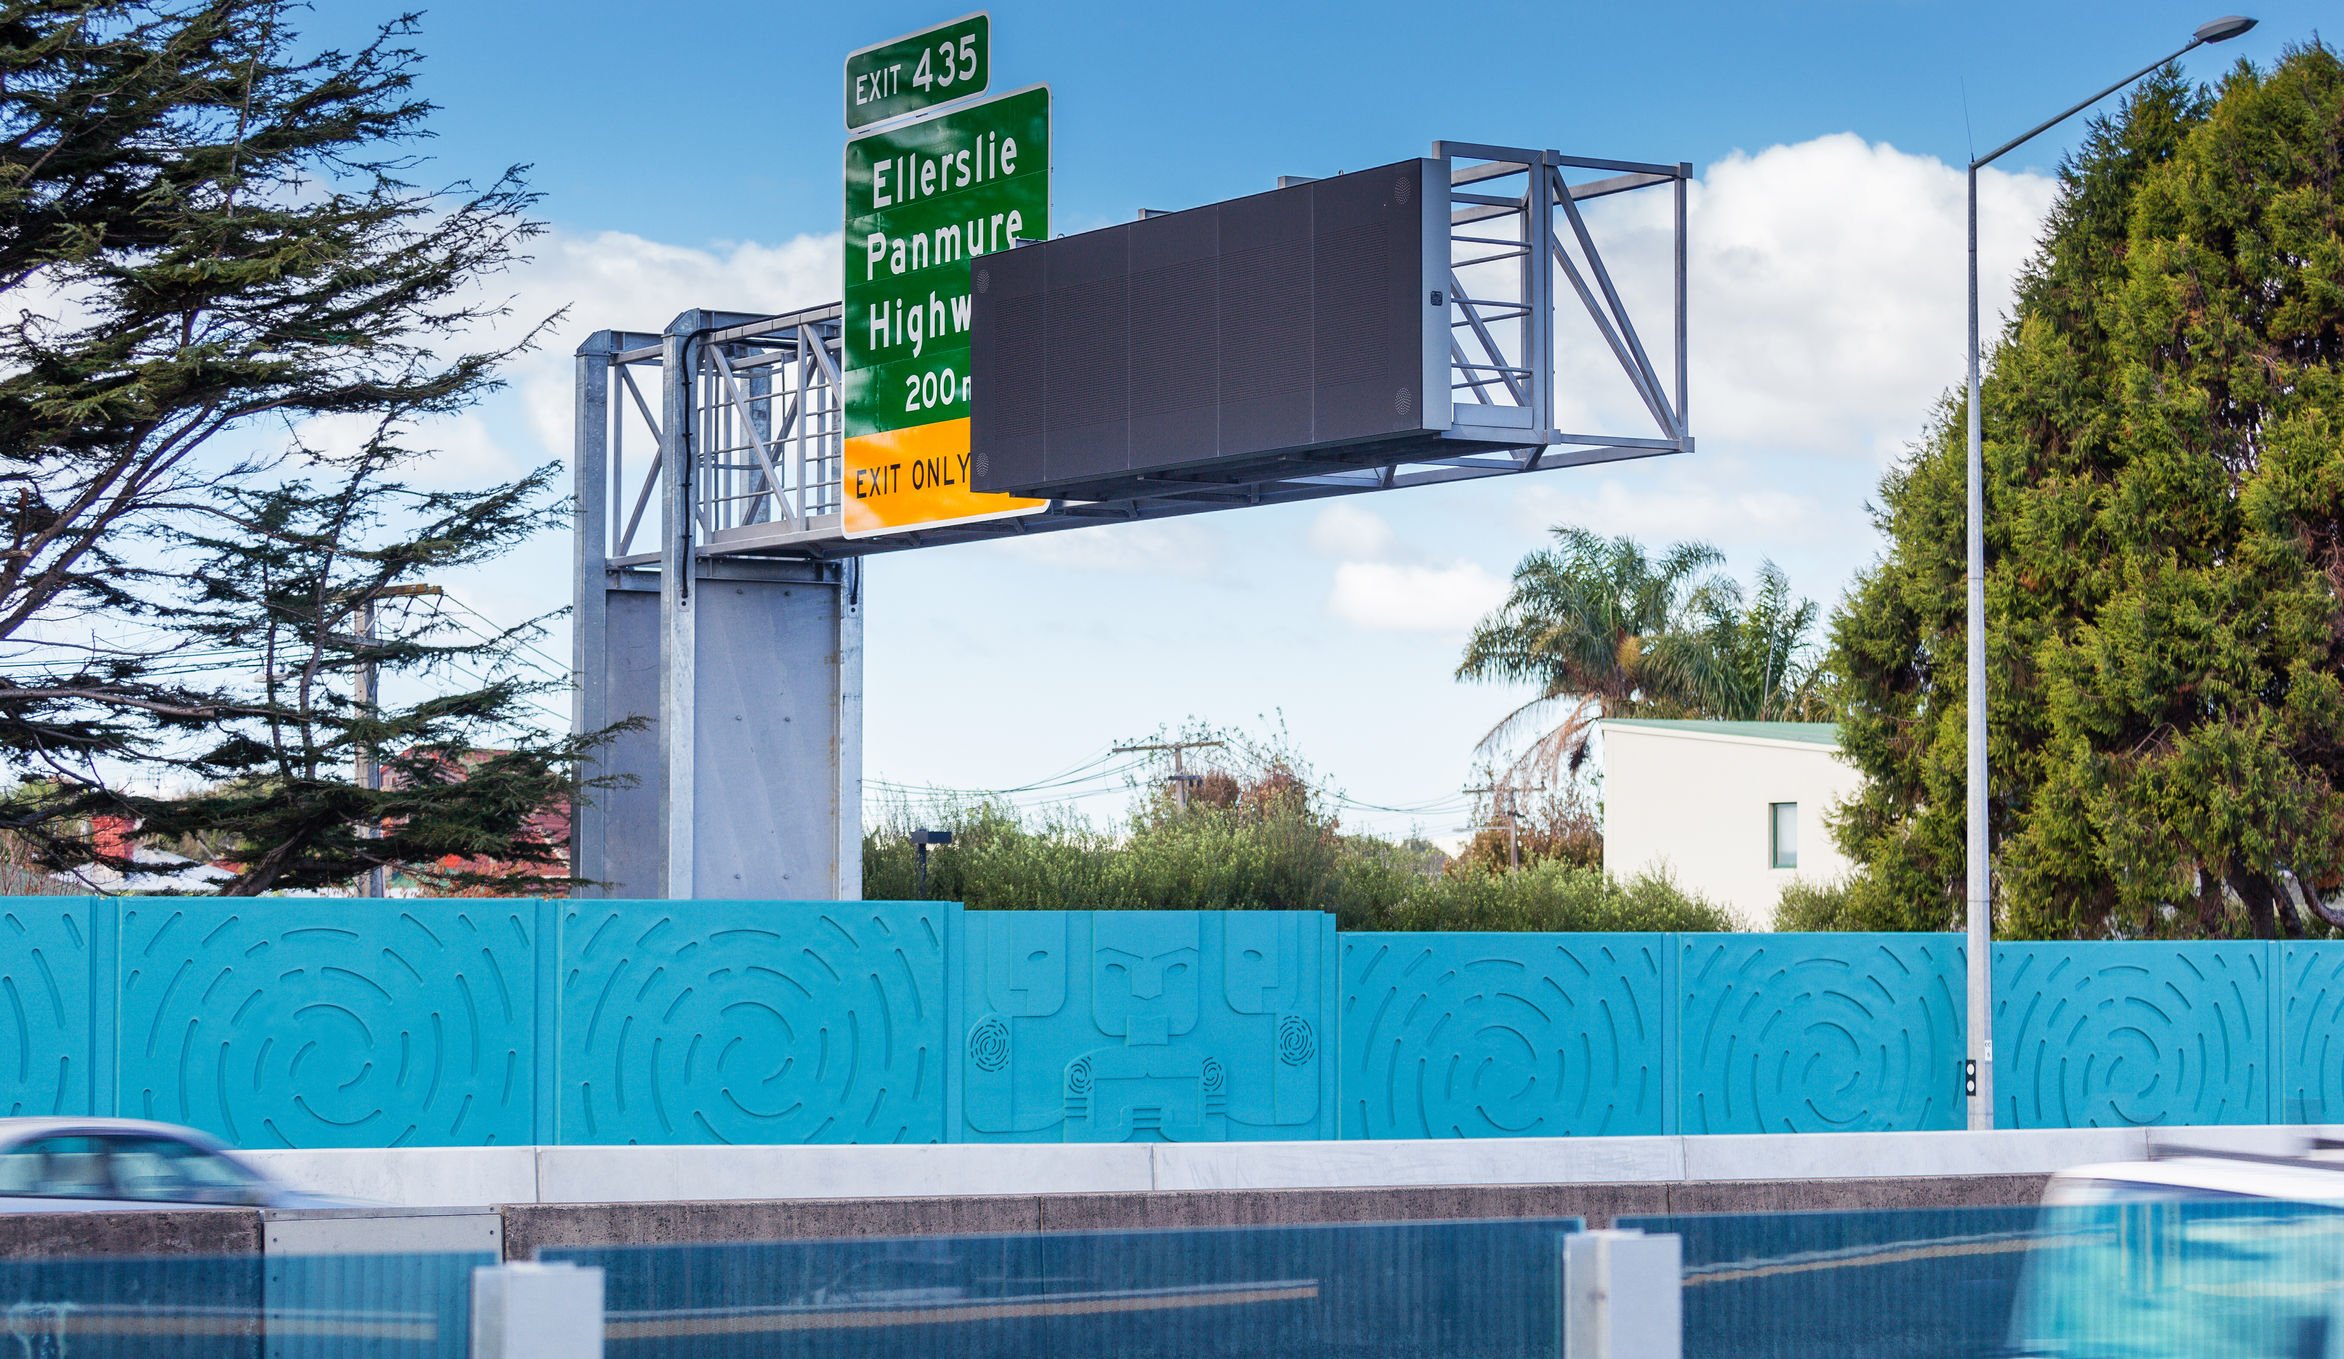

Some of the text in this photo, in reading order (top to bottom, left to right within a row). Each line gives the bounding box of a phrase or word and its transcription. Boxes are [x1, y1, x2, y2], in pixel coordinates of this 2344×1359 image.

[856, 33, 977, 106] EXIT 435
[873, 130, 1018, 209] Ellerslie
[867, 209, 1023, 281] Panmure
[905, 367, 956, 412] 200
[856, 452, 971, 499] EXIT ONLY
